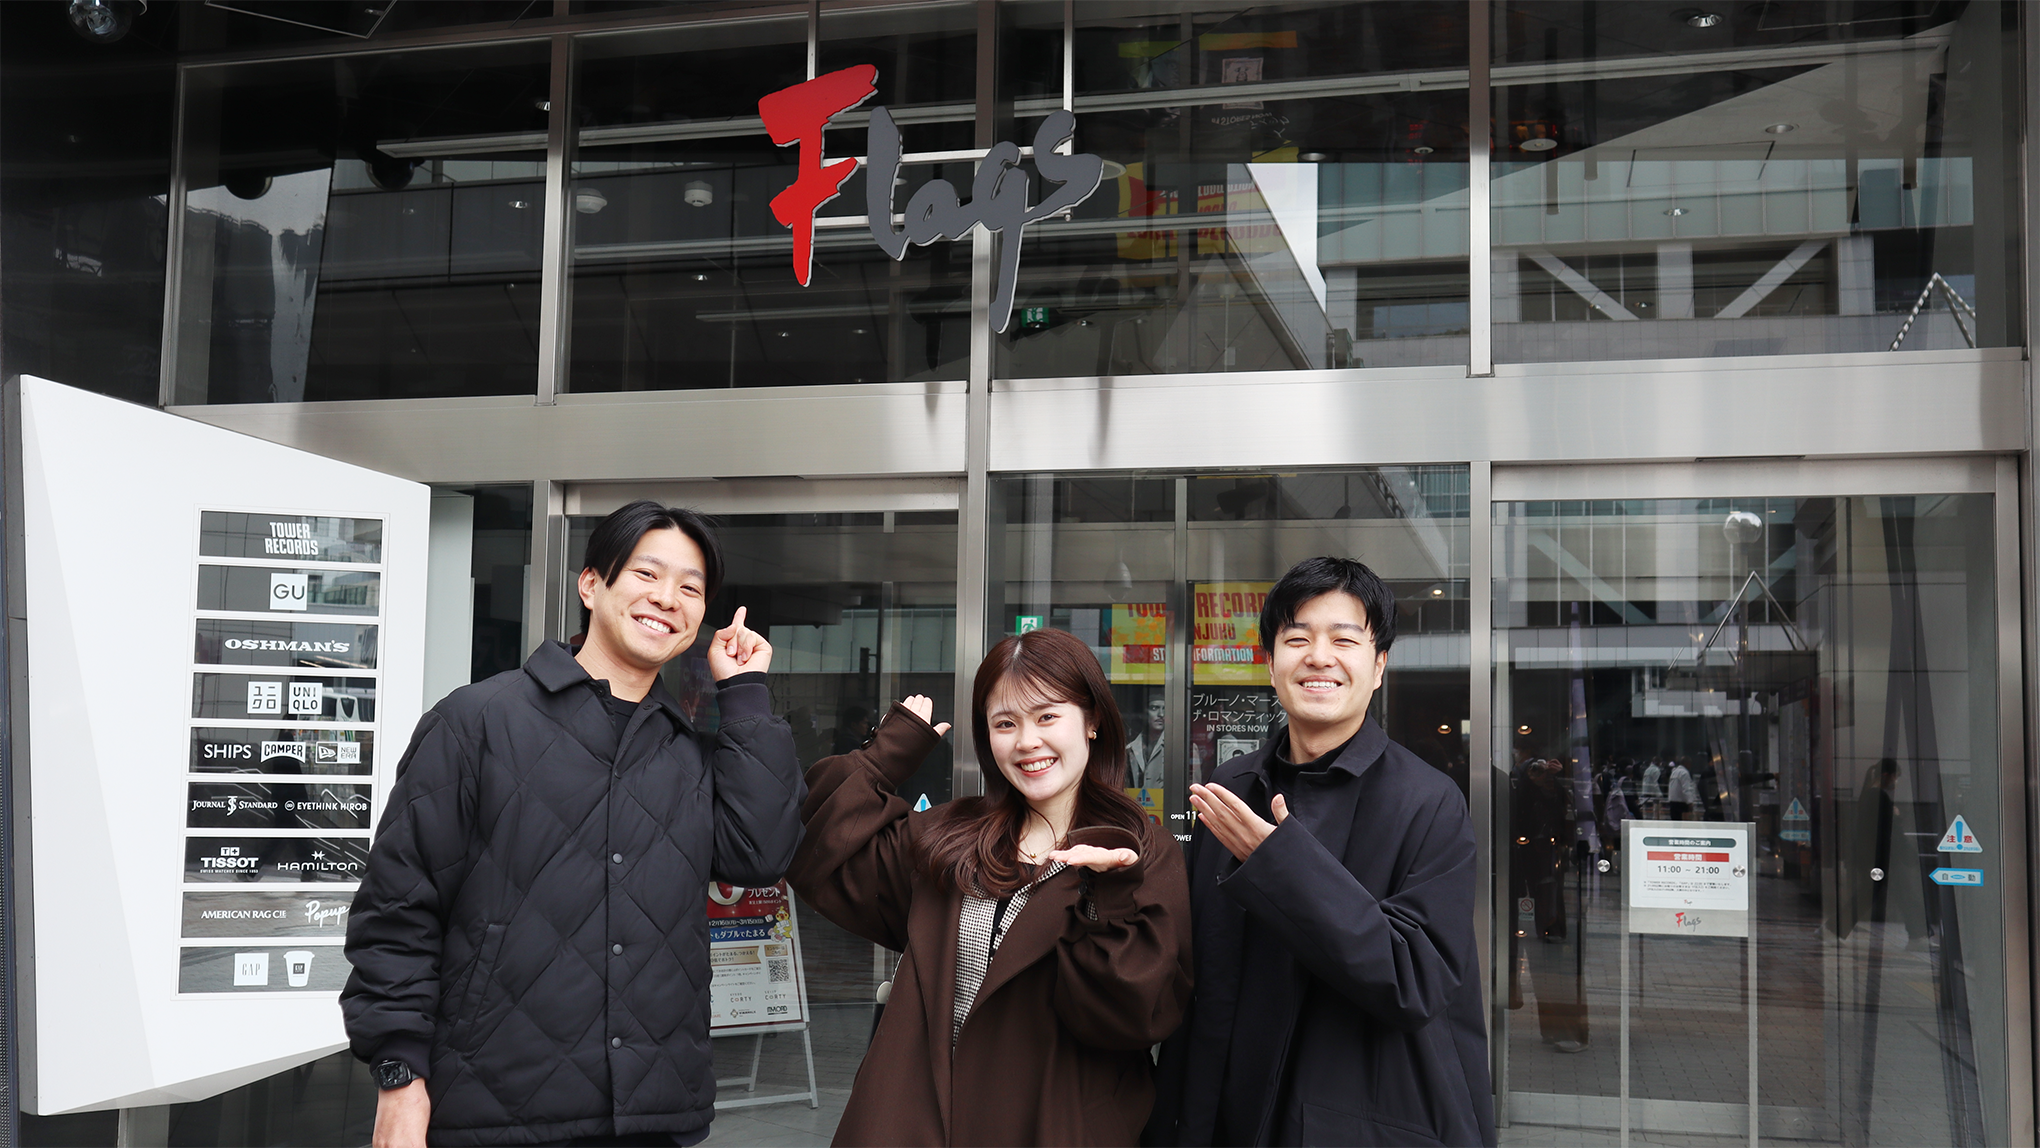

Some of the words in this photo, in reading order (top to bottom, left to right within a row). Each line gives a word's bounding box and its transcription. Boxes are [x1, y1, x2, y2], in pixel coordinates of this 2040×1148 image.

[758, 64, 1104, 333] Flags
[269, 521, 311, 539] TOWER
[264, 538, 319, 556] RECORDS
[273, 583, 305, 600] GU
[224, 638, 350, 653] OSHMAN'S
[1193, 647, 1254, 662] FORMATION
[292, 687, 317, 698] UNI
[292, 699, 318, 711] QLO
[1206, 724, 1215, 732] IN
[1216, 724, 1246, 732] STORES
[1247, 725, 1269, 733] NOW
[203, 743, 252, 759] SHIPS
[263, 743, 304, 758] CAMPER
[191, 800, 226, 811] JOURNAL
[238, 800, 278, 810] STANDARD
[297, 802, 338, 811] EYETHINK
[340, 802, 367, 811] HIROB
[200, 857, 259, 868] TISSOT
[1673, 853, 1703, 861] 営業時間
[277, 862, 358, 871] HAMILTON
[1657, 865, 1682, 873] 11:00
[1695, 866, 1720, 874] 21:00
[201, 910, 251, 919] AMERICAN
[252, 910, 272, 919] RAG
[304, 900, 351, 928] Popup
[1675, 912, 1702, 932] Flags
[242, 963, 261, 976] GAP
